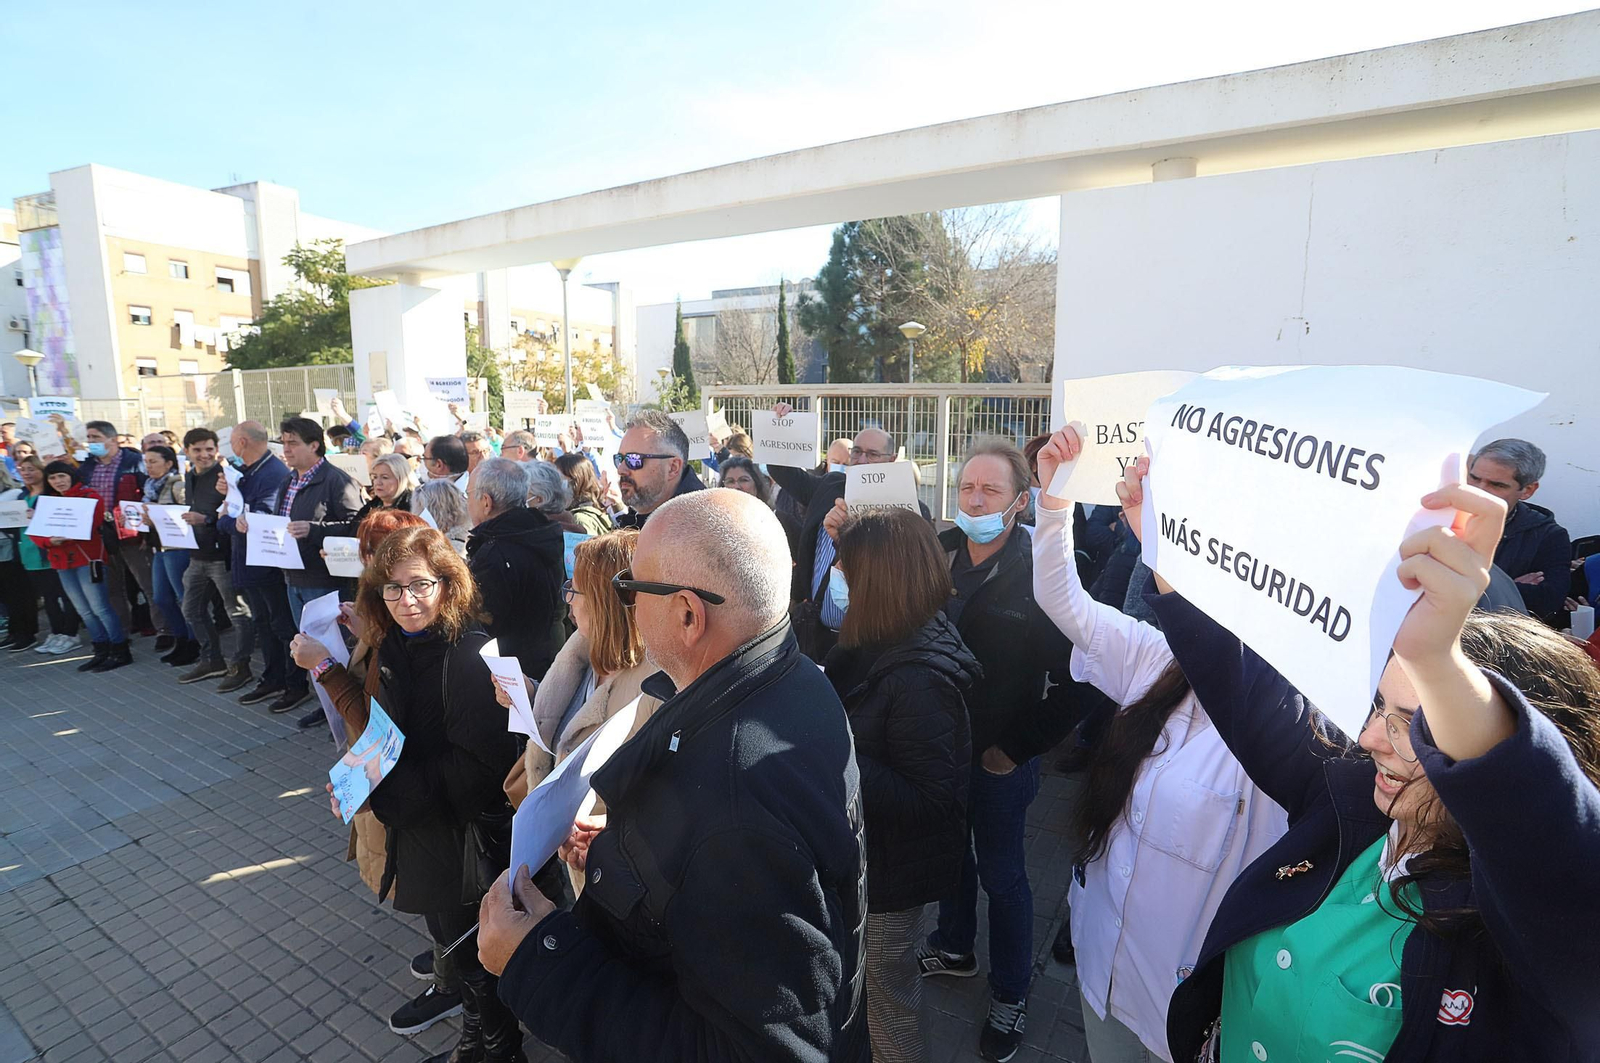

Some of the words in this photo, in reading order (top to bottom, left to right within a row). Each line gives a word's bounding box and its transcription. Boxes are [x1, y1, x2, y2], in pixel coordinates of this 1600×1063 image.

[772, 418, 794, 427] STOP
[759, 439, 813, 452] AGRESIONES
[1170, 403, 1207, 435] NO
[1206, 411, 1386, 491] AGRESIONES
[861, 473, 886, 484] STOP
[1161, 511, 1201, 557] MÁS
[1206, 537, 1353, 643] SEGURIDAD
